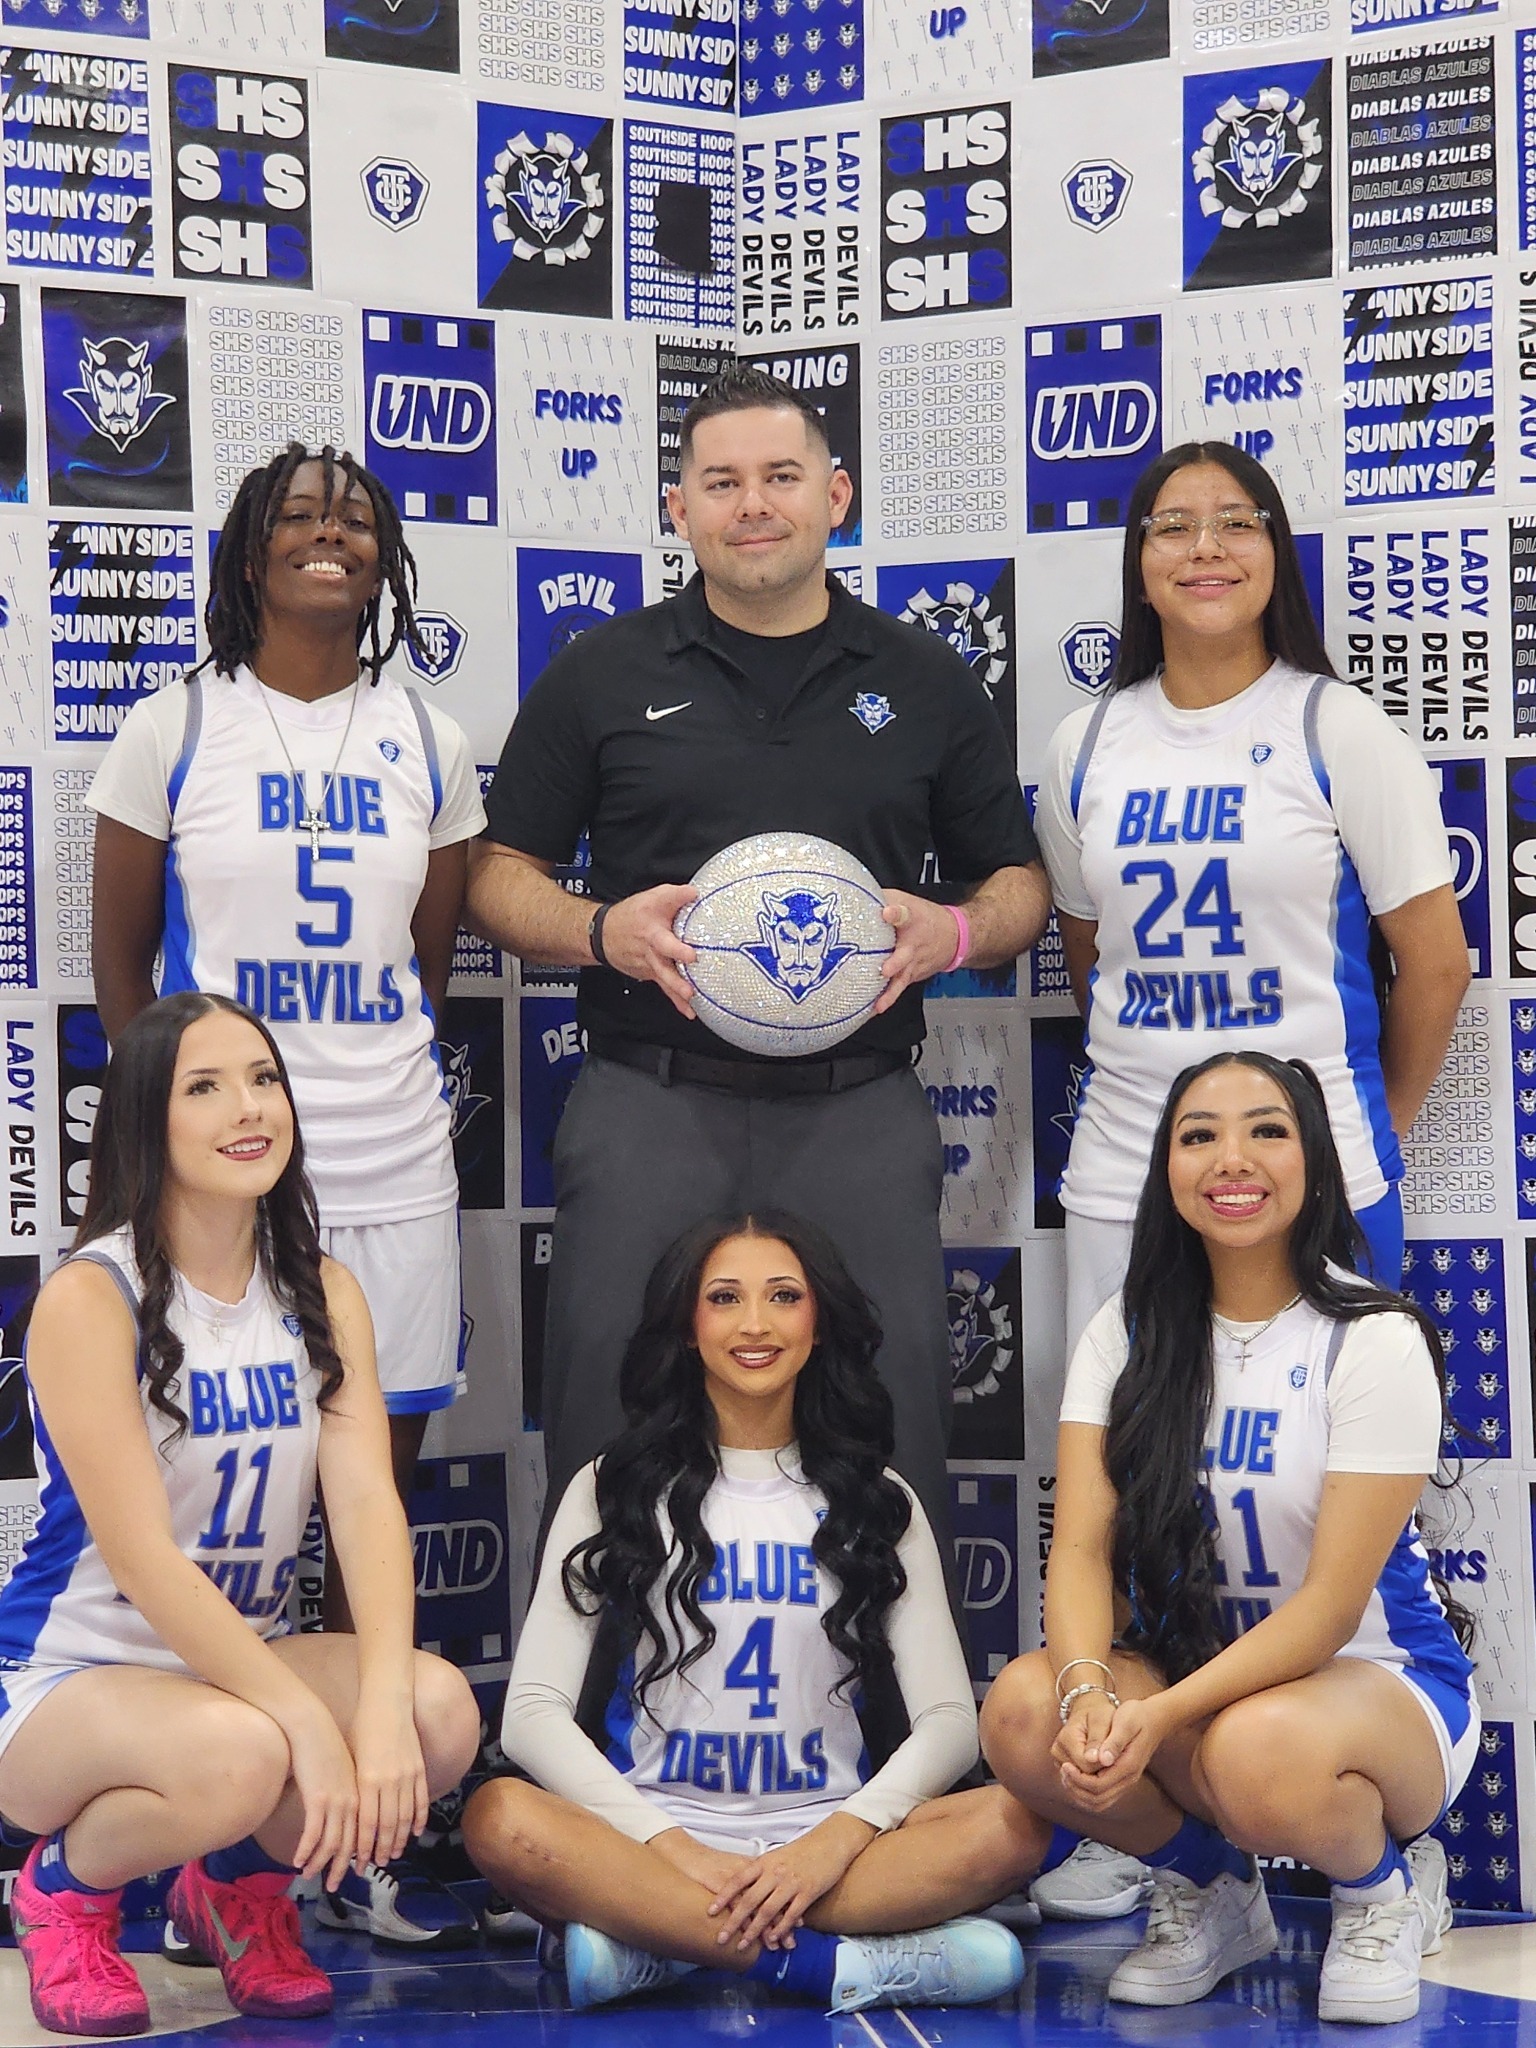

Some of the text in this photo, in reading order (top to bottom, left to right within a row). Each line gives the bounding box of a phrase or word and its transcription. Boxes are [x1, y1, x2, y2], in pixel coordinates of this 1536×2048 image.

[479, 13, 604, 47] SHS SHS SHS
[929, 6, 967, 39] UP
[1194, 11, 1330, 49] SHS SHS SHS
[478, 34, 604, 68] SHS SHS SHS
[624, 28, 735, 67] SUNNYSID
[0, 50, 148, 92] NNYSIDE
[479, 58, 604, 91] SHS SHS SHS
[624, 67, 735, 108] SUNNYSID
[1350, 58, 1490, 92] DIABLAS AZULES
[175, 72, 304, 138] SHS
[1350, 86, 1491, 120] DIABLAS AZULES
[629, 125, 734, 152] SOUTHSIDE HOOP
[886, 110, 1007, 175] SHS
[1350, 115, 1491, 149] DIABLAS AZULES
[2, 138, 151, 180] SUNNYSIDE
[629, 145, 696, 166] SOUTHSIDE
[629, 163, 696, 183] SOUTHSIDE
[1351, 143, 1491, 177] DIABLAS AZULES
[178, 143, 306, 209] SHS
[1352, 169, 1493, 201] DIABLAS AZULES
[836, 131, 860, 327] LADY DEVILS
[886, 179, 1007, 243] SHS
[1352, 197, 1493, 229] DIABLAS AZULES
[179, 215, 308, 280] SHS
[742, 144, 764, 335] LADY DEVILS
[771, 139, 798, 333] LADY DEVILS
[804, 136, 827, 330] LADY DEVILS
[1352, 226, 1493, 257] DIABLAS AZULES
[630, 282, 696, 302] SOUTHSIDE
[886, 248, 1007, 311] SHS
[630, 299, 696, 319] SOUTHSIDE
[1344, 279, 1493, 321] NNYSIDE
[209, 306, 342, 336] SHS SHS SHS
[211, 353, 343, 382] SHS SHS SHS
[659, 354, 718, 373] DIABLAS
[879, 337, 1005, 365] SHS SHS SHS
[879, 382, 1005, 409] SHS SHS SHS
[1204, 367, 1303, 406] FORKS
[1344, 368, 1493, 410] SUNNYSIDE
[212, 398, 344, 426] SHS SHS SHS
[371, 375, 491, 452] UND
[535, 389, 622, 425] FORKS
[1031, 381, 1157, 460] UND
[879, 425, 1005, 451] SHS SHS SHS
[1234, 428, 1274, 462] UP
[561, 448, 597, 479] UP
[880, 445, 1006, 472] SHS SHS SHS
[881, 468, 1006, 494] SHS SHS SHS
[1345, 459, 1495, 498] SUNNYSIDE
[49, 525, 192, 557] NNYSIDE
[882, 512, 1007, 539] SHS SHS SHS
[538, 573, 616, 616] DEVIL
[50, 614, 195, 645] SUNNYSIDE
[1348, 535, 1375, 696] LADY DEV
[1383, 533, 1414, 736] LADY DEVIL
[1461, 529, 1489, 740] LADY DEVILS
[1422, 531, 1449, 741] LADY DEVILS
[257, 771, 389, 838] BLUE
[1114, 784, 1247, 848] BLUE
[296, 844, 355, 948] 5
[1120, 857, 1246, 958] 24
[452, 953, 494, 967] HOOPS
[235, 958, 404, 1025] DEVILS
[1117, 966, 1284, 1031] DEVILS
[6, 1020, 35, 1113] LADY
[1445, 1122, 1493, 1142] SHS
[1402, 1146, 1494, 1167] SHS SHS
[9, 1124, 37, 1236] DEVILS
[1402, 1170, 1494, 1192] SHS SHS
[1403, 1193, 1496, 1214] SHS SHS
[189, 1359, 302, 1438] BLUE
[1200, 1406, 1282, 1477] UE
[196, 1443, 273, 1549] 11
[699, 1539, 820, 1608] BLUE
[1426, 1548, 1488, 1582] RKS
[193, 1558, 297, 1618] VILS
[723, 1616, 781, 1720] 4
[658, 1727, 829, 1796] DEVILS
